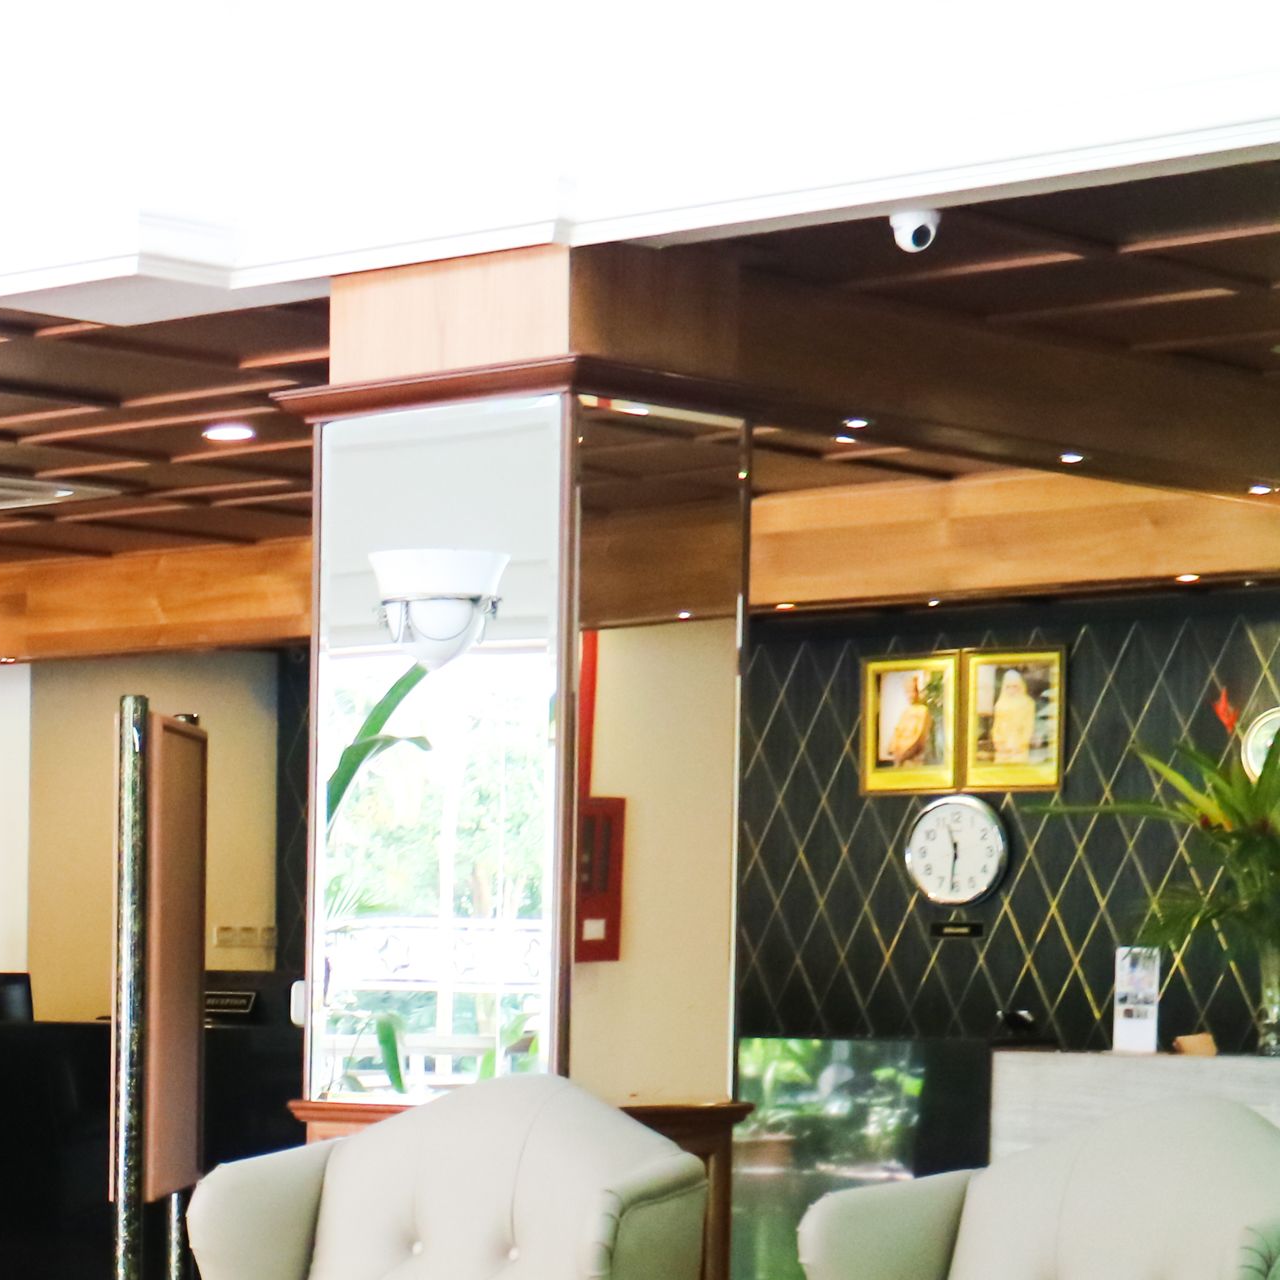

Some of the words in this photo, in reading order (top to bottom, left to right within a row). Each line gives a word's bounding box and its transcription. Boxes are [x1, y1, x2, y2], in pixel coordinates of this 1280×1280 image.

[951, 811, 962, 823] 12
[925, 829, 937, 841] 10
[980, 827, 989, 840] 2
[918, 846, 927, 859] 9
[985, 845, 994, 858] 3
[924, 863, 933, 876] 8
[980, 863, 988, 874] 4
[937, 876, 945, 888] 7
[967, 876, 976, 889] 5
